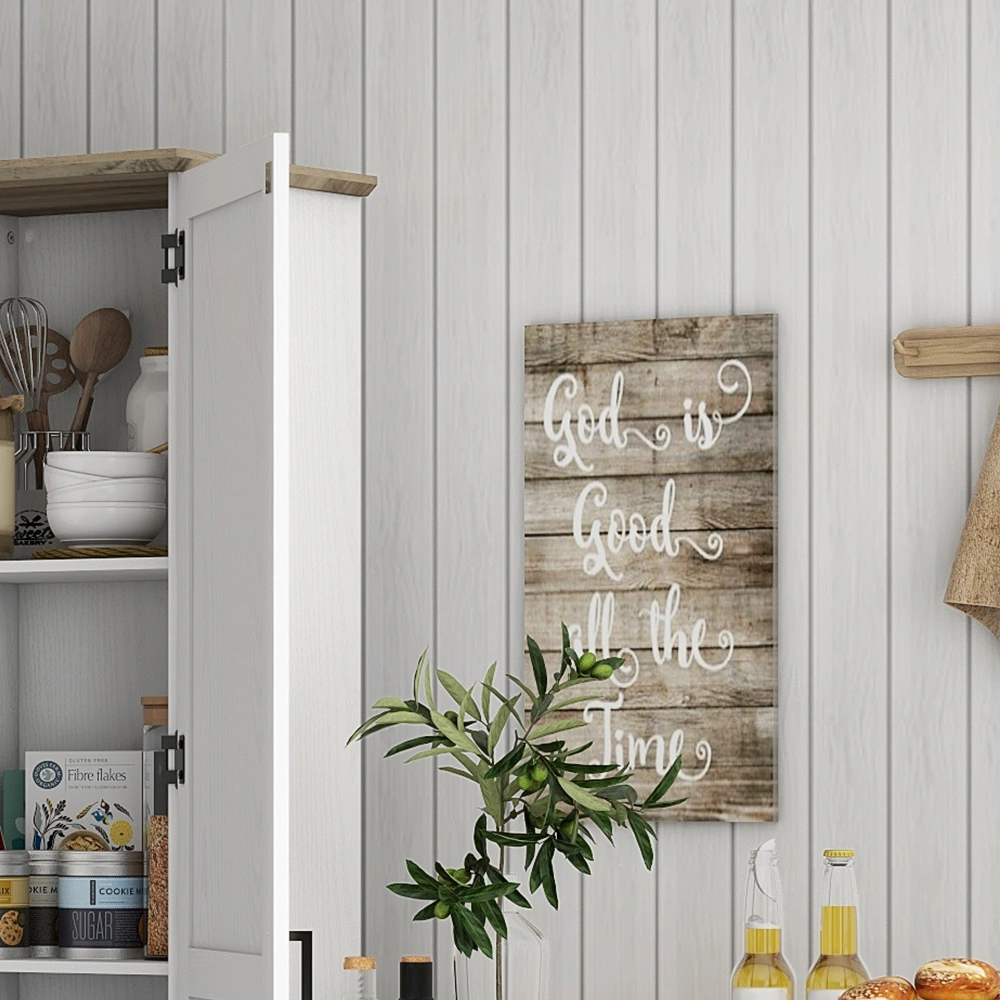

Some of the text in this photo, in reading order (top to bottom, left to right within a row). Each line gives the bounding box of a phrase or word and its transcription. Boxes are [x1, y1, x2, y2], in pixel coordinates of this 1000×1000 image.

[543, 359, 752, 472] God is
[13, 526, 56, 540] weets
[572, 478, 724, 582] Good
[638, 582, 735, 671] the
[583, 692, 712, 781] Time
[68, 768, 127, 781] Fibre flakes
[99, 887, 134, 895] COOKIE
[72, 911, 113, 940] SUGAR
